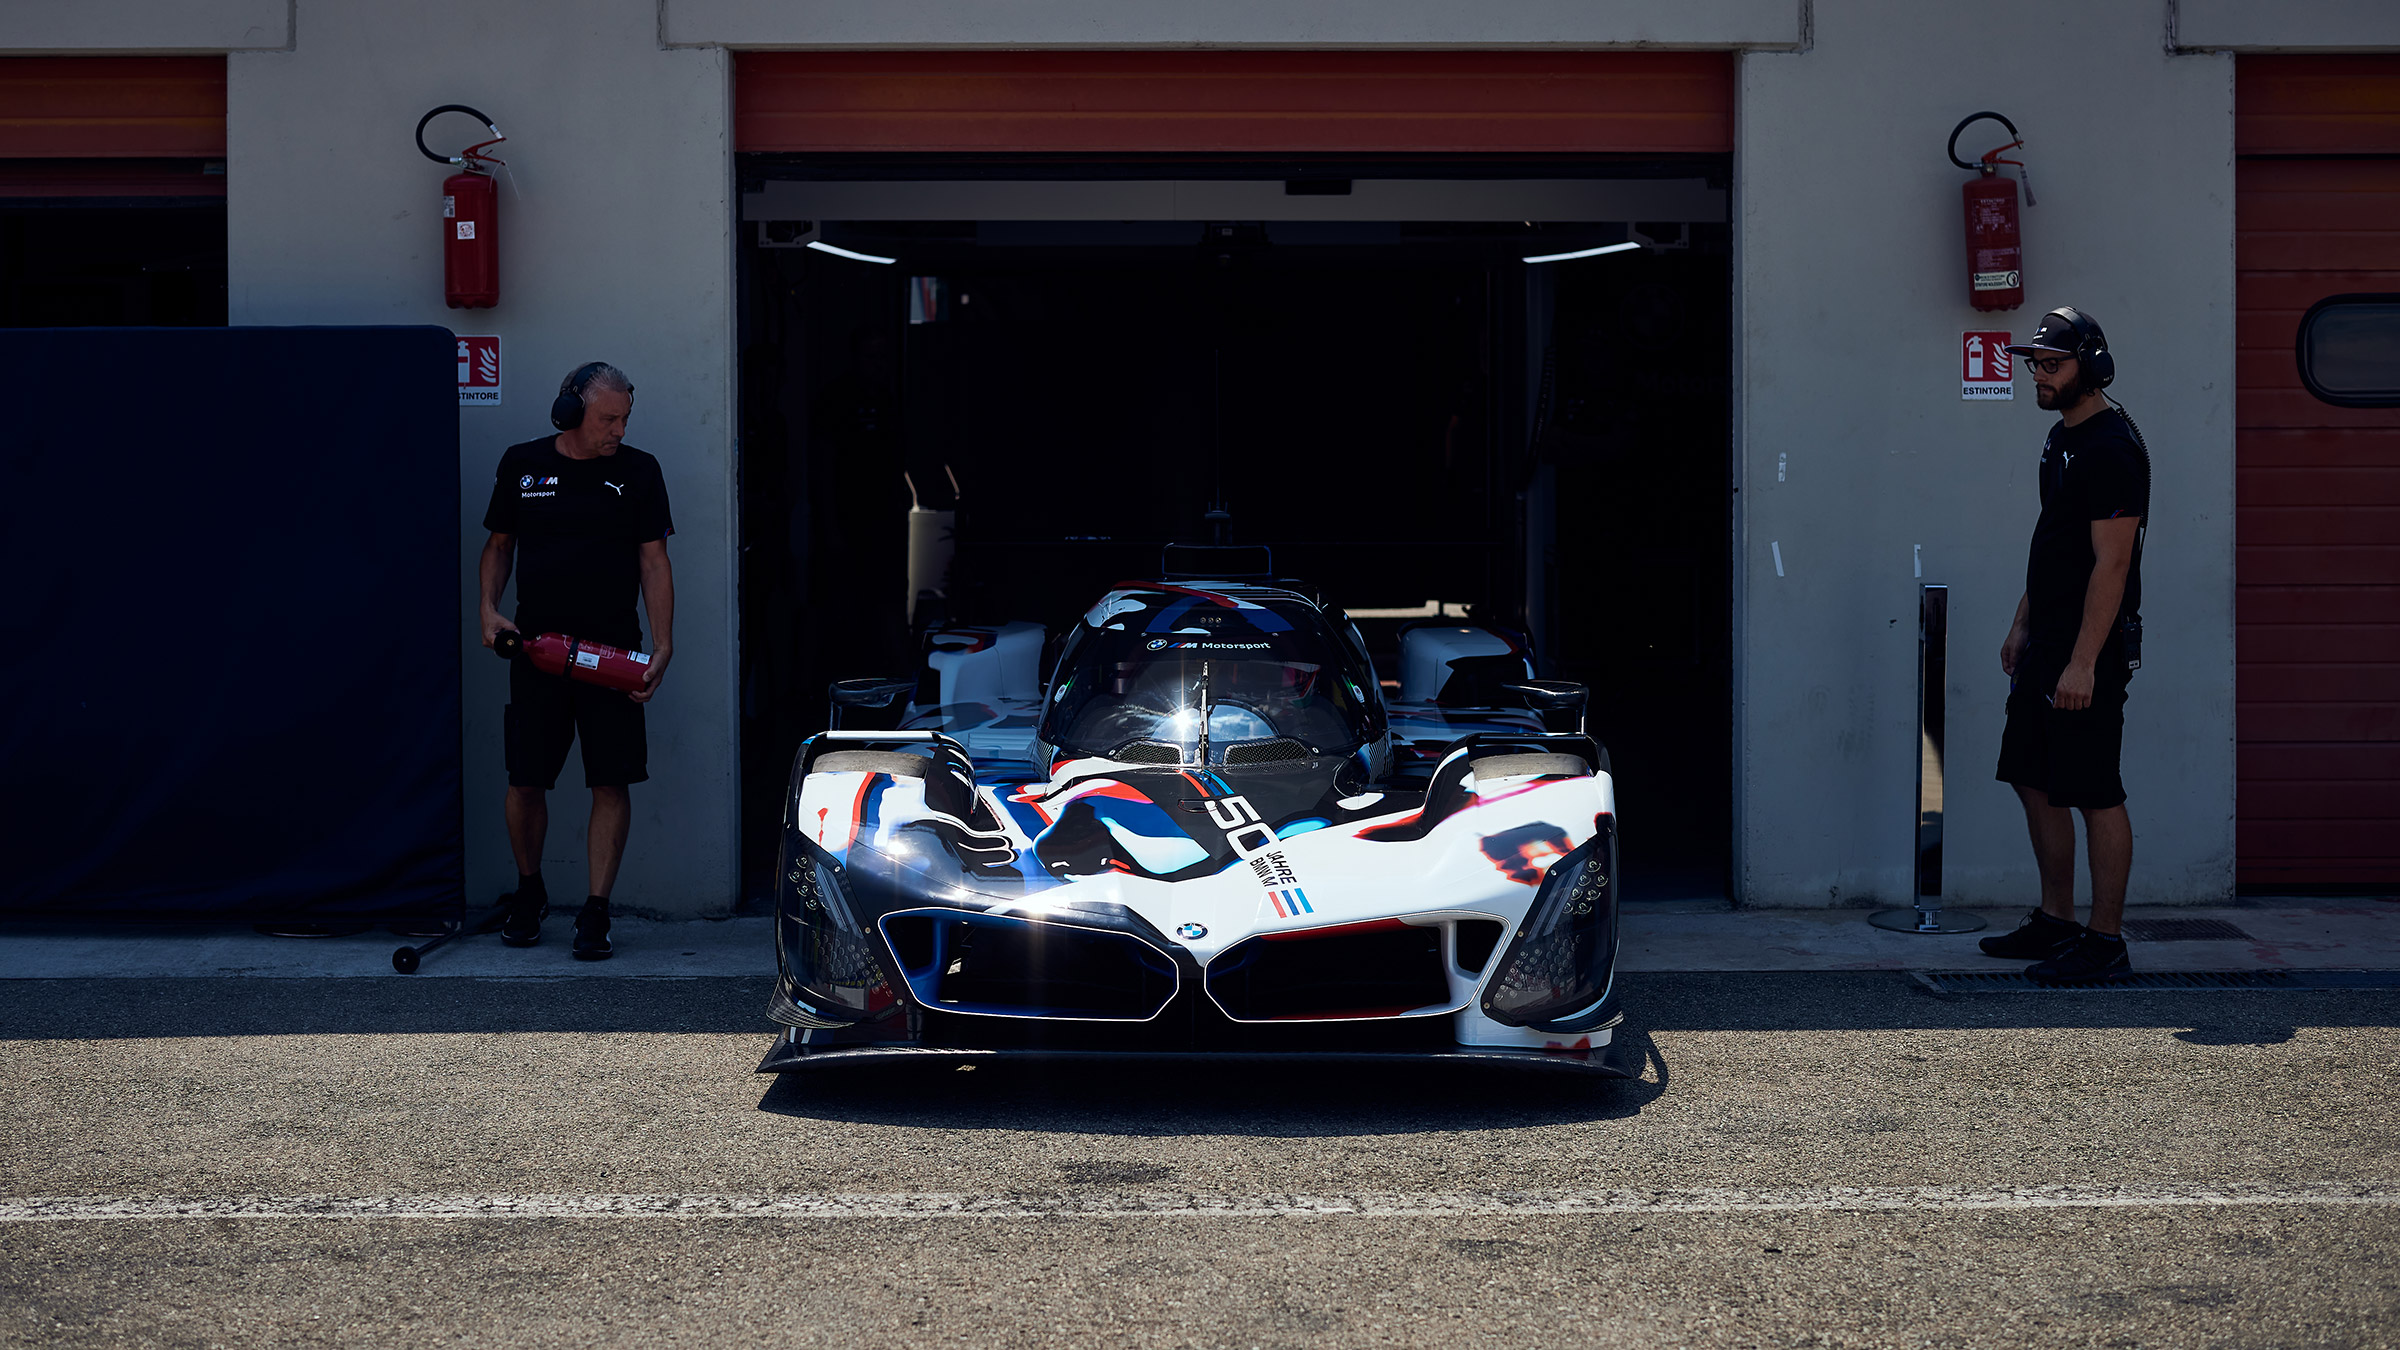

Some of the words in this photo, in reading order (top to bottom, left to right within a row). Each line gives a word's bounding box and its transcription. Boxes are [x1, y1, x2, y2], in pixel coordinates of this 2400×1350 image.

[1963, 386, 2011, 395] ESTINTORE
[521, 491, 556, 499] Motorsport
[1202, 642, 1271, 650] Motorsport
[1204, 795, 1281, 861] 50
[1249, 856, 1273, 878] BMW
[1261, 876, 1279, 887] M
[1266, 850, 1298, 884] JAHRE
